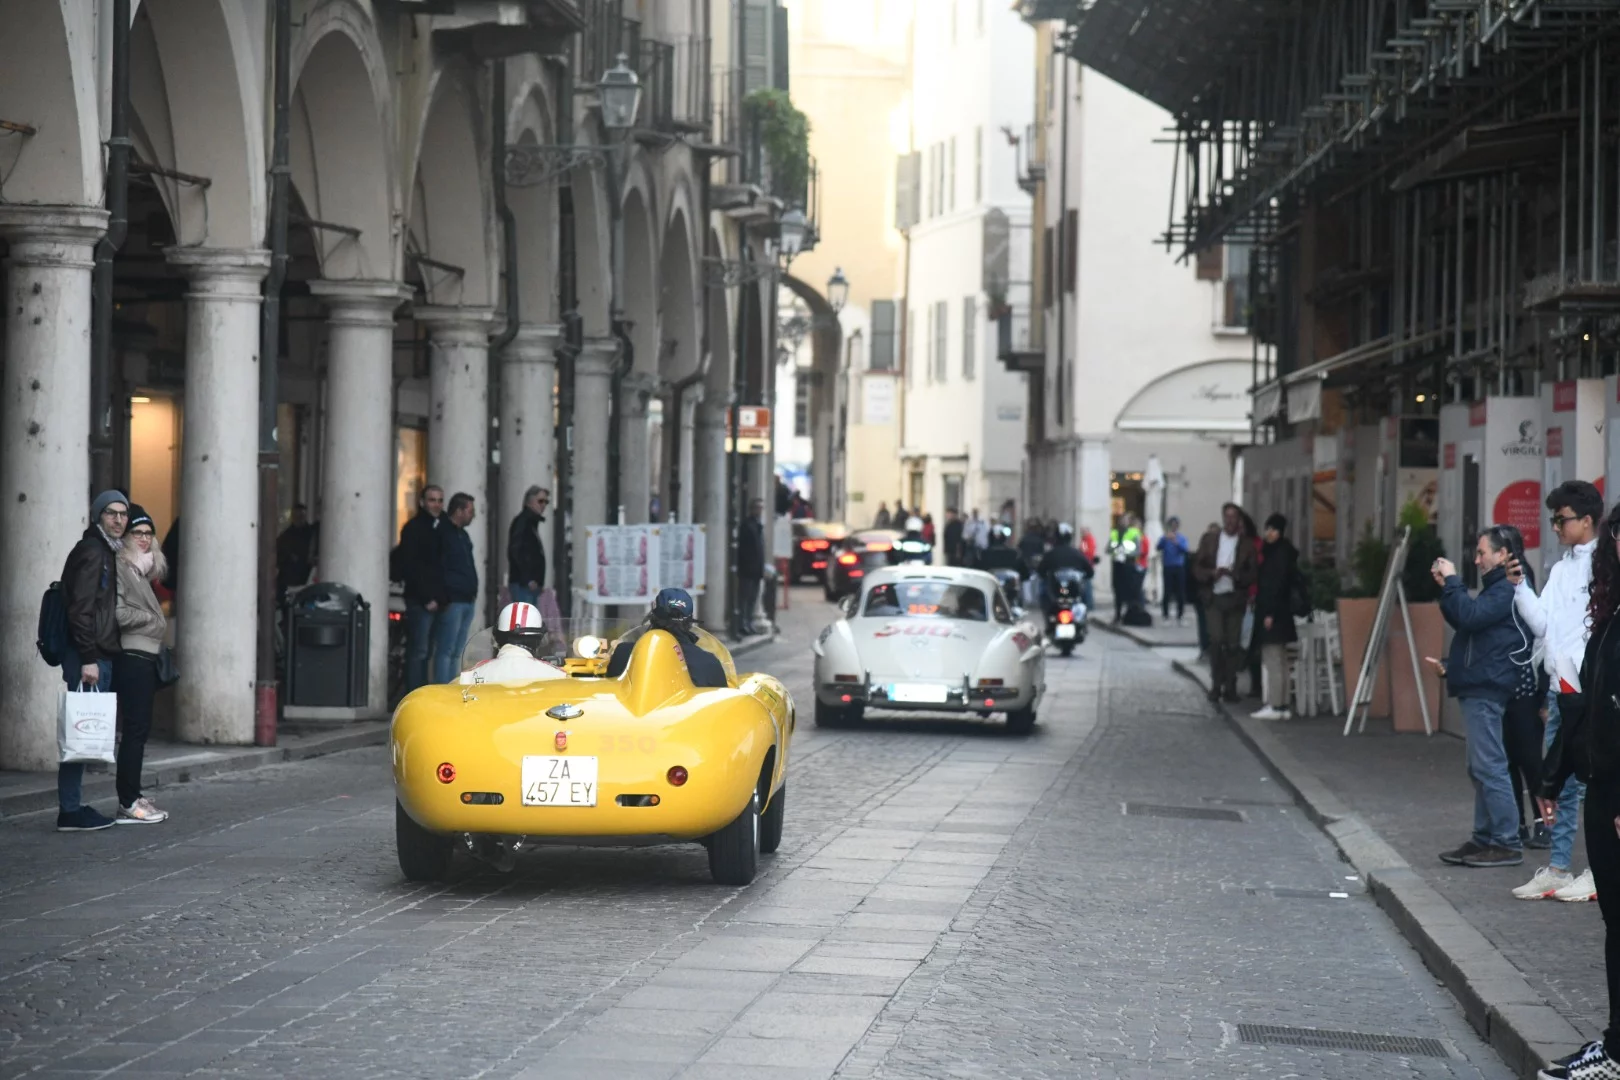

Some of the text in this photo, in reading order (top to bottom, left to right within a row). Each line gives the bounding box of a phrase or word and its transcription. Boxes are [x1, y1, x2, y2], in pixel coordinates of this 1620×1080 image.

[548, 759, 571, 779] ZA
[525, 782, 593, 803] 457 EY
